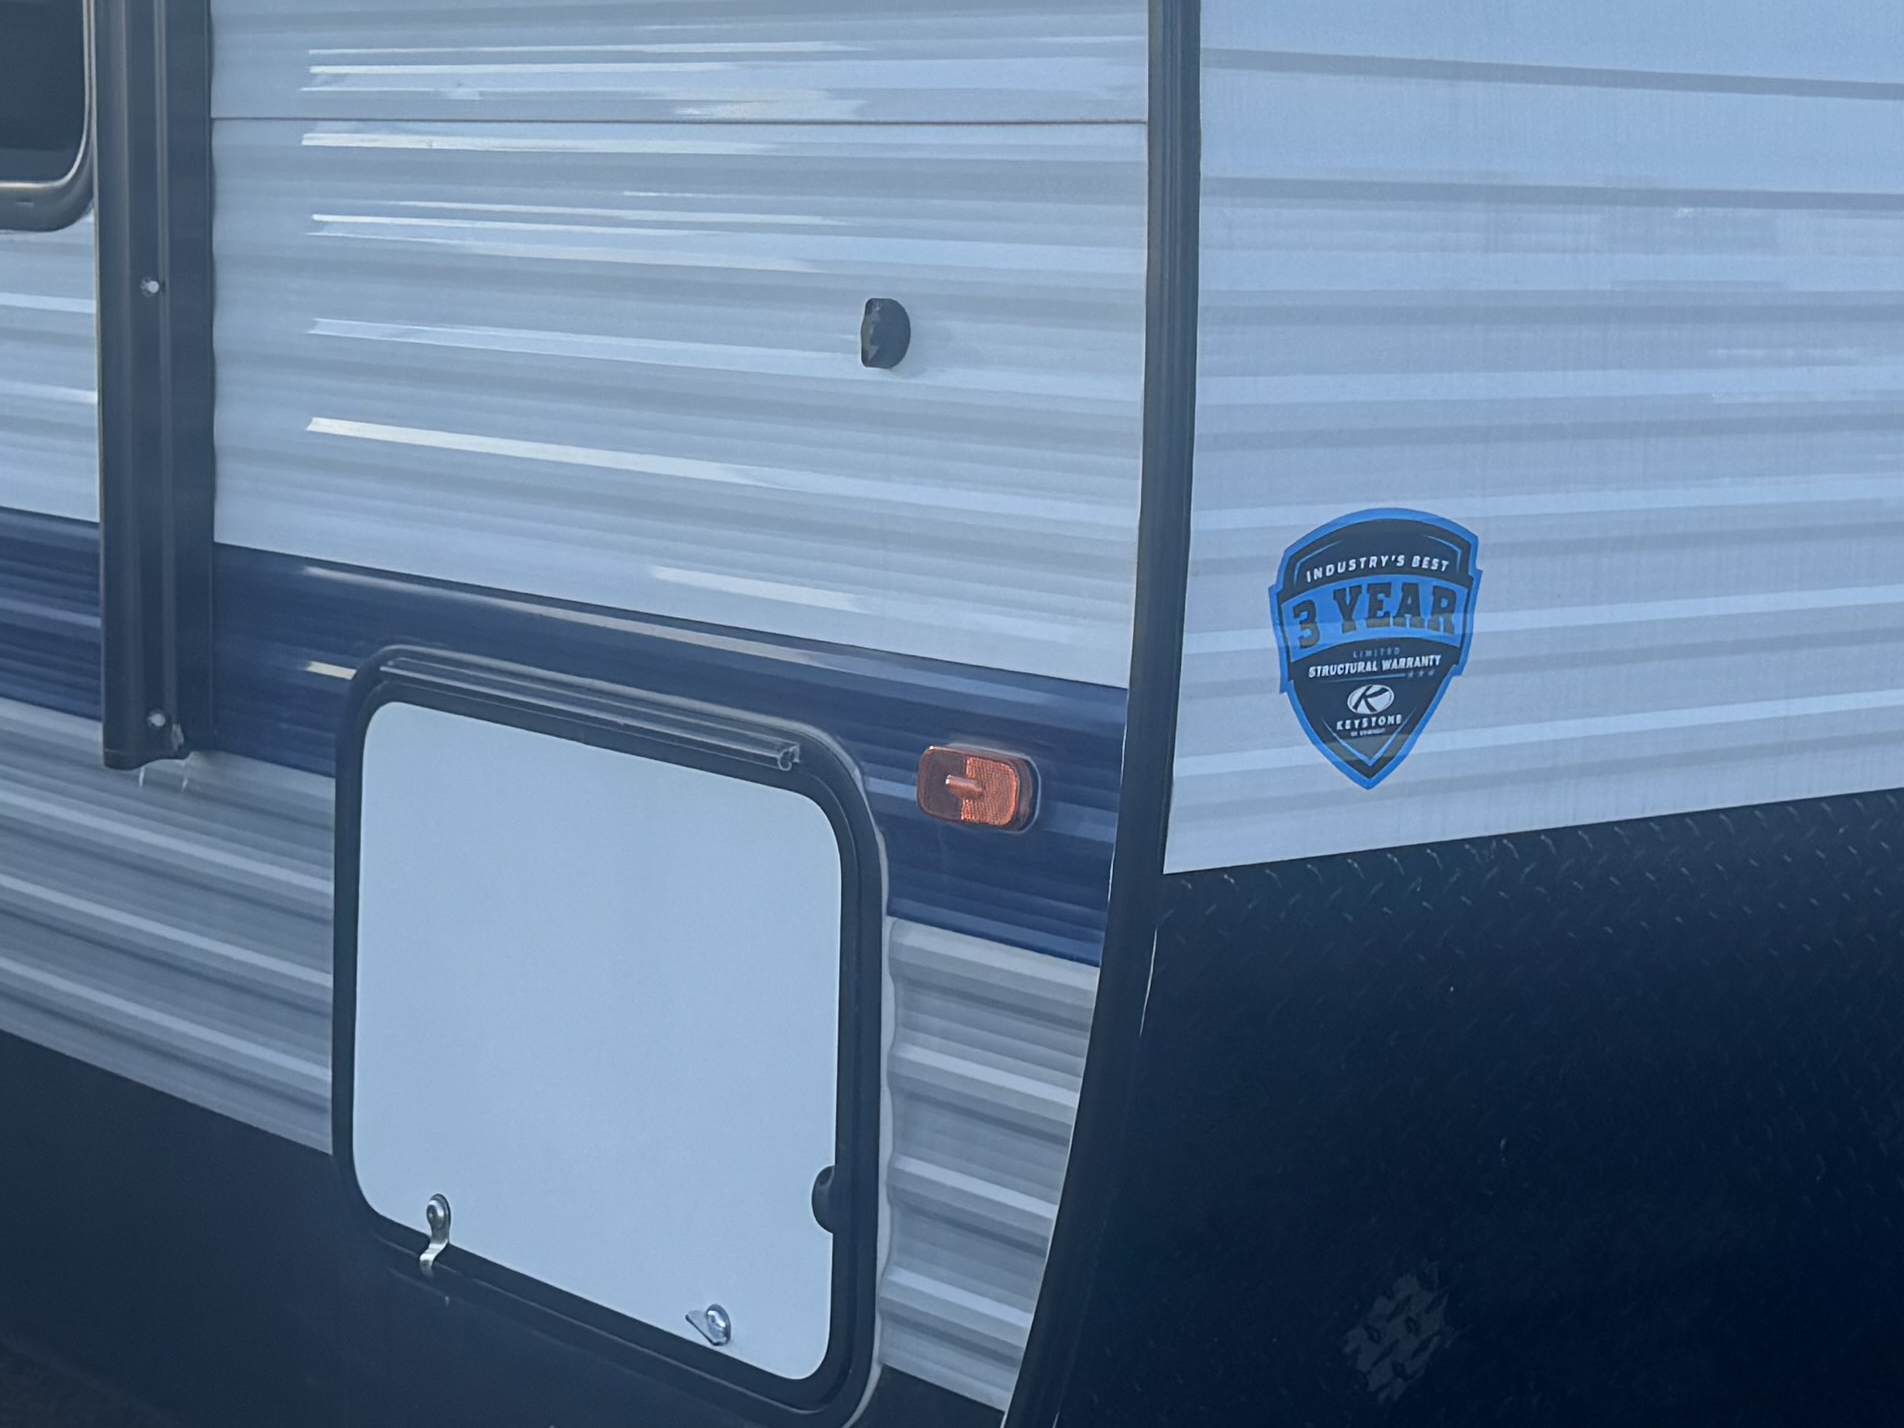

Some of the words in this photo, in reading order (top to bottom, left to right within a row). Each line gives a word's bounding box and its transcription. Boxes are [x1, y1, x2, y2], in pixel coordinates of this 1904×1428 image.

[1306, 555, 1405, 583] INDUSTRY'S
[1411, 555, 1449, 572] BEST
[1292, 599, 1321, 649] 3
[1333, 581, 1457, 636] YEAR
[1308, 660, 1378, 678] STRUCTURAL
[1382, 654, 1442, 672] WARRANTY
[1336, 714, 1402, 730] KEYSTONE
